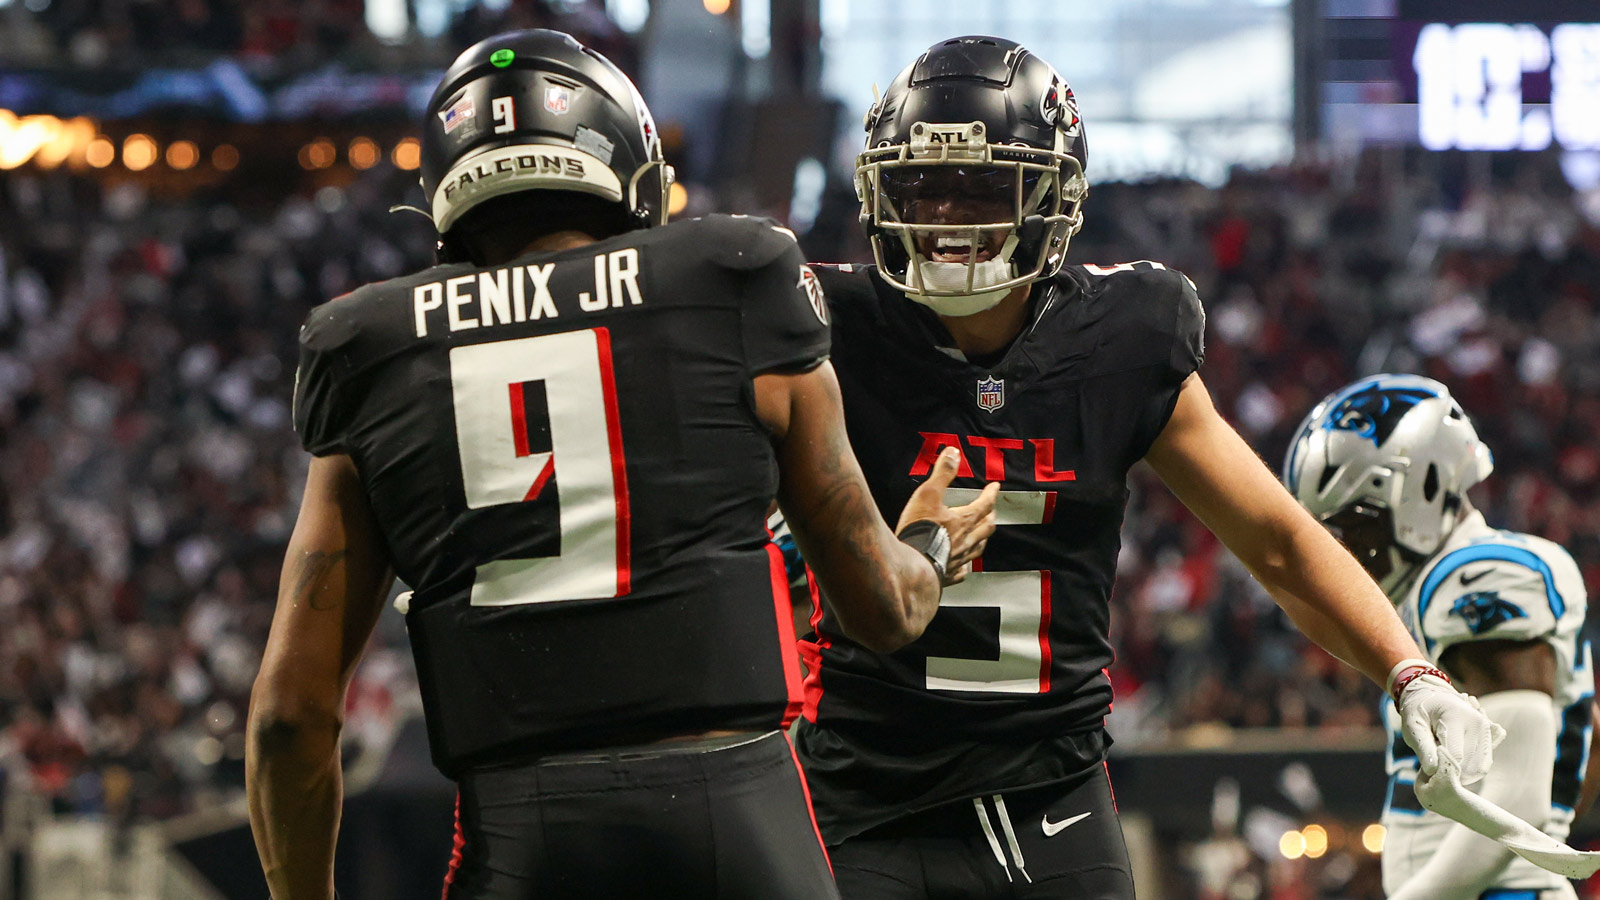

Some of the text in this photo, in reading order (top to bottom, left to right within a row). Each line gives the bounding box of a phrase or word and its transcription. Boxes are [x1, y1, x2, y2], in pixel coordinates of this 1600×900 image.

[492, 96, 517, 135] 9
[548, 99, 567, 112] NFL
[930, 131, 968, 143] ATL
[443, 154, 586, 200] FALCONS
[413, 247, 644, 339] PENIX JR
[981, 393, 1001, 407] NFL
[449, 326, 632, 608] 9
[908, 431, 1077, 482] ATL
